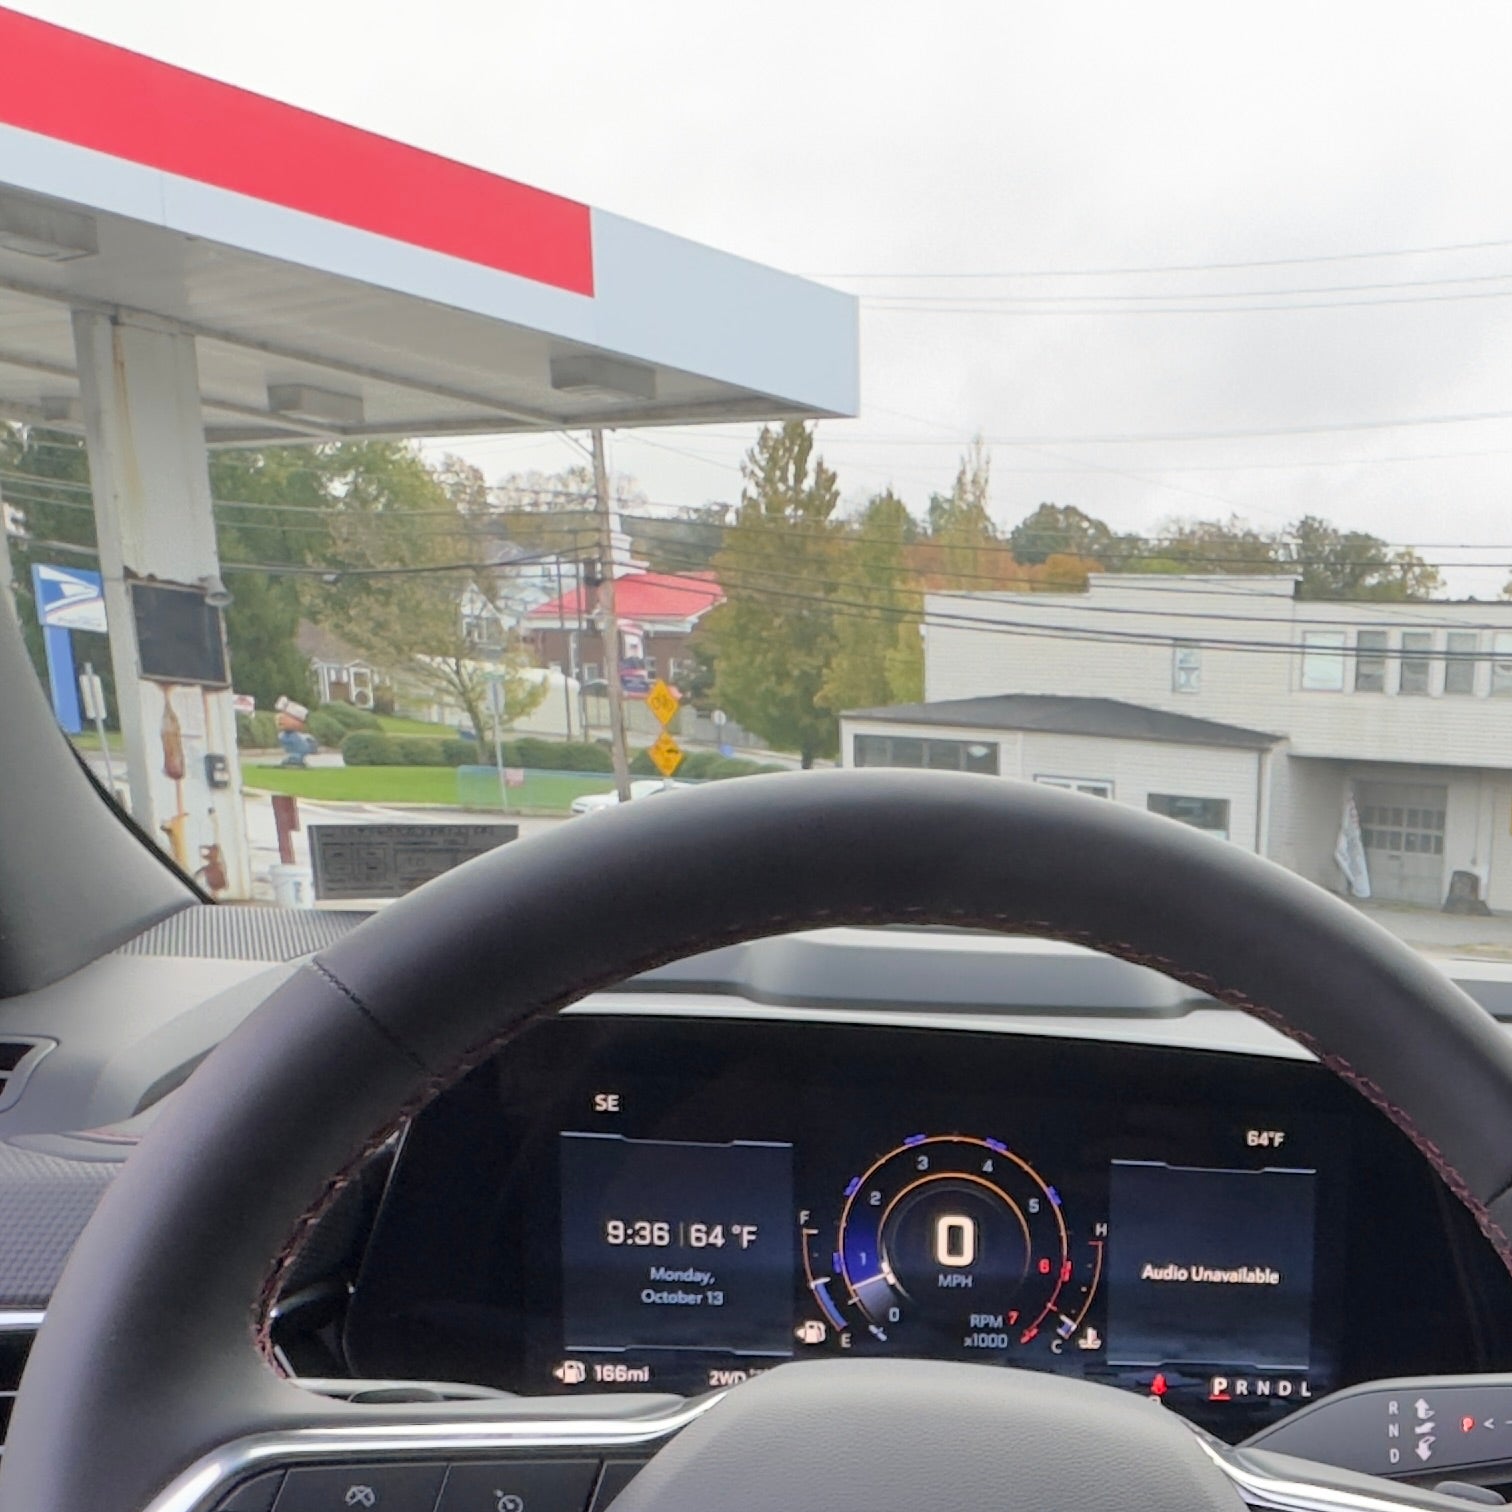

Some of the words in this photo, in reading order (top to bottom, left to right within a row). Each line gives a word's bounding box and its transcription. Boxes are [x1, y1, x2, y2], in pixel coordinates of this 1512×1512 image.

[594, 1094, 620, 1112] SE
[1246, 1130, 1285, 1149] 64°F
[916, 1155, 929, 1171] 3
[982, 1158, 994, 1173] 4
[869, 1191, 882, 1206] 2
[1028, 1198, 1040, 1214] 5
[800, 1210, 810, 1225] F
[606, 1220, 670, 1246] 9:36
[689, 1224, 726, 1249] 64
[1095, 1223, 1108, 1237] H
[935, 1214, 976, 1268] 0
[859, 1251, 867, 1266] 1
[1038, 1258, 1050, 1274] 6
[650, 1266, 715, 1286] Monday,
[938, 1273, 973, 1289] MPH
[1141, 1263, 1189, 1283] Audio
[1191, 1265, 1280, 1286] Unavailable
[641, 1288, 703, 1305] October
[707, 1291, 724, 1306] 13
[888, 1306, 900, 1322] 0
[970, 1313, 1003, 1329] RPM
[1007, 1310, 1020, 1326] 7
[841, 1332, 852, 1348] E
[963, 1332, 1009, 1349] x1000
[1051, 1339, 1064, 1355] C
[593, 1363, 650, 1384] 166mi
[708, 1369, 748, 1386] 2WD
[1213, 1376, 1228, 1396] P
[1236, 1380, 1249, 1396] R
[1256, 1380, 1271, 1396] N
[1277, 1380, 1293, 1397] D
[1300, 1381, 1312, 1398] L
[1388, 1400, 1399, 1416] R
[1388, 1423, 1400, 1438] N
[1461, 1416, 1474, 1433] P
[1389, 1448, 1401, 1464] D
